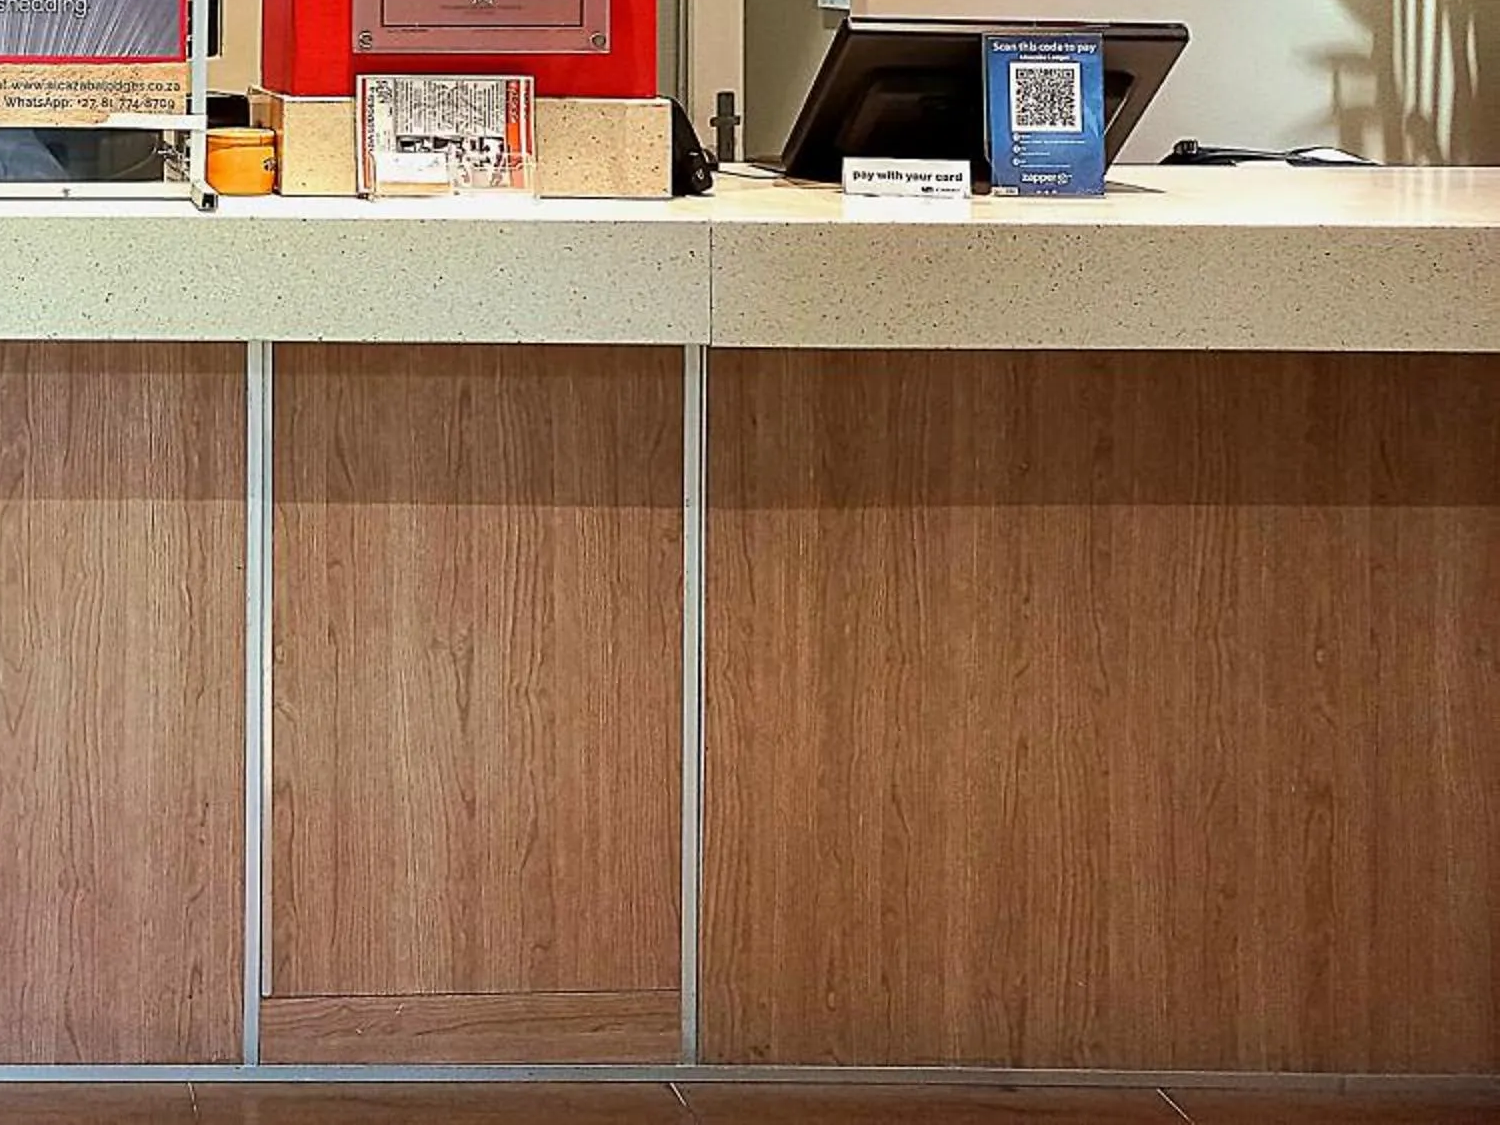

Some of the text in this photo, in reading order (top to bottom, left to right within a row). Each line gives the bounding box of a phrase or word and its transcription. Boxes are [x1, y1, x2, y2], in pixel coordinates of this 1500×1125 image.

[993, 41, 1098, 54] Scan this code to pay
[852, 170, 964, 183] pay with your card
[1022, 173, 1057, 185] zapper
